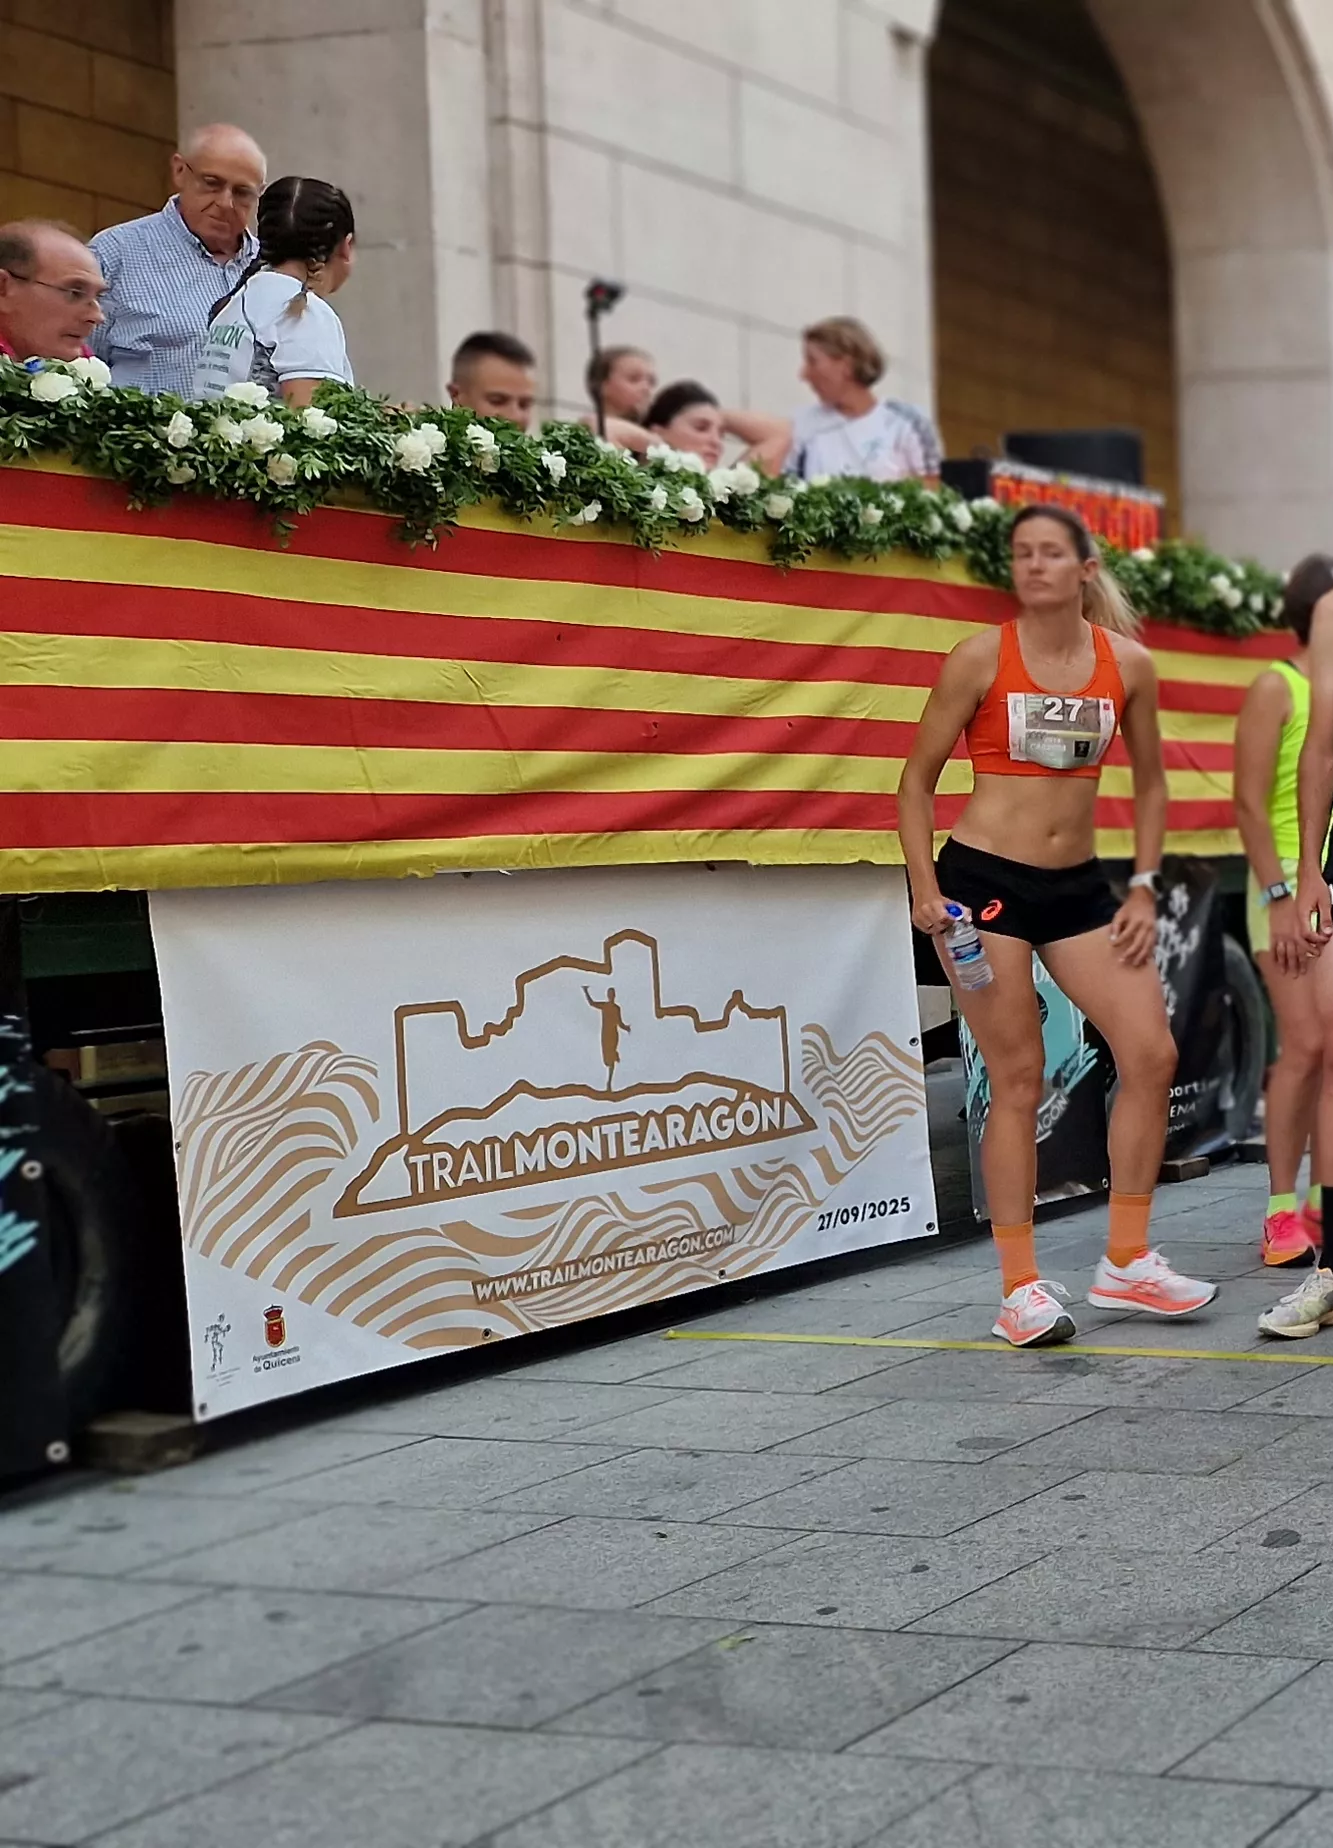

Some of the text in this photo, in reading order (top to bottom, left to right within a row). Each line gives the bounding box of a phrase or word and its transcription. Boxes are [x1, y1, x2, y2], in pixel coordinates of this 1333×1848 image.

[1043, 697, 1083, 722] 27
[408, 1091, 783, 1195] TRAILMONTEARAGÓN
[817, 1196, 911, 1232] 27/09/2025
